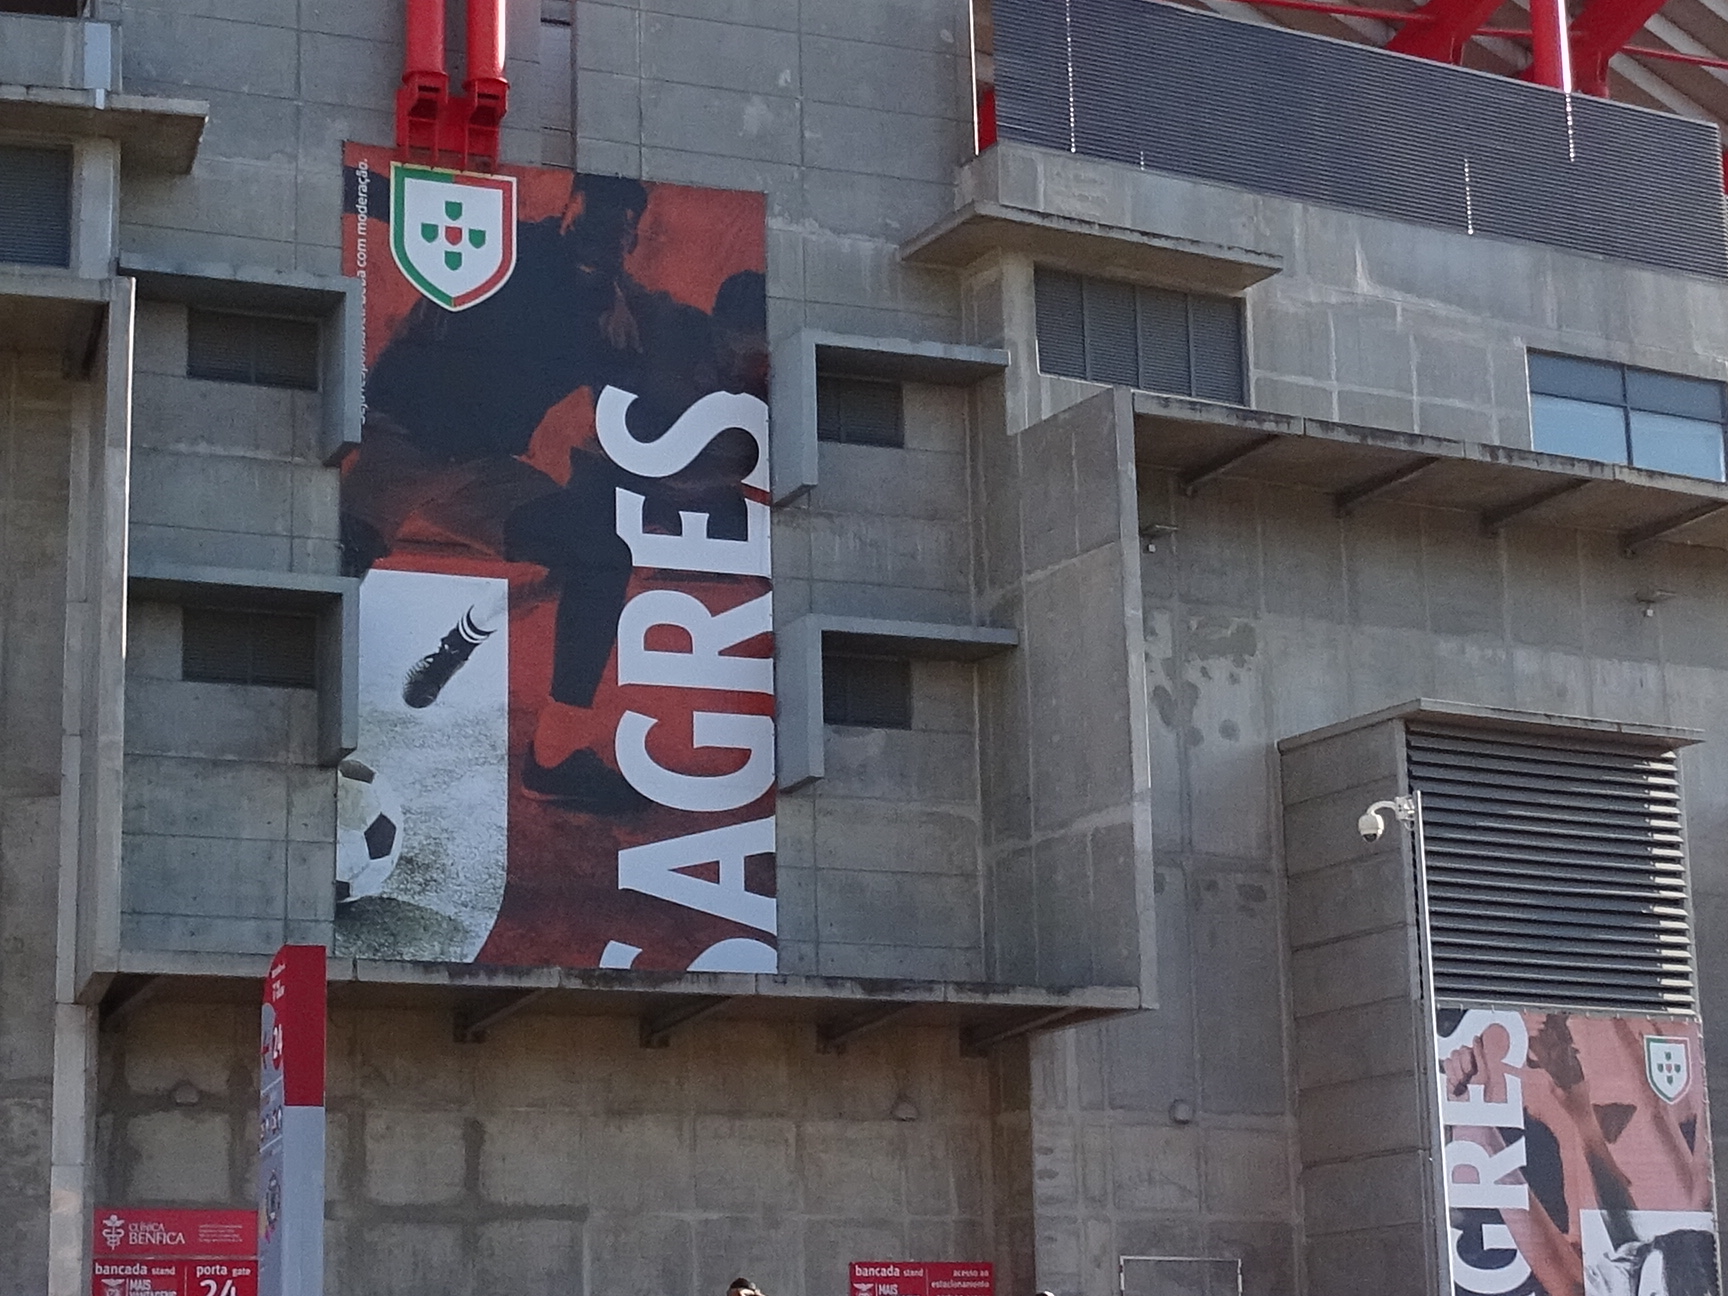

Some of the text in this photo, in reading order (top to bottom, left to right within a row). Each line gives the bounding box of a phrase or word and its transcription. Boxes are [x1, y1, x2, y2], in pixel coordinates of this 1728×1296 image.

[356, 158, 368, 241] moderação.
[357, 245, 367, 268] com
[129, 1232, 185, 1244] BENFICA
[95, 1263, 175, 1275] bancada stand
[196, 1265, 251, 1277] porta gate
[855, 1265, 923, 1277] bancada stand
[129, 1279, 152, 1291] MAIS
[878, 1284, 898, 1295] MAIS
